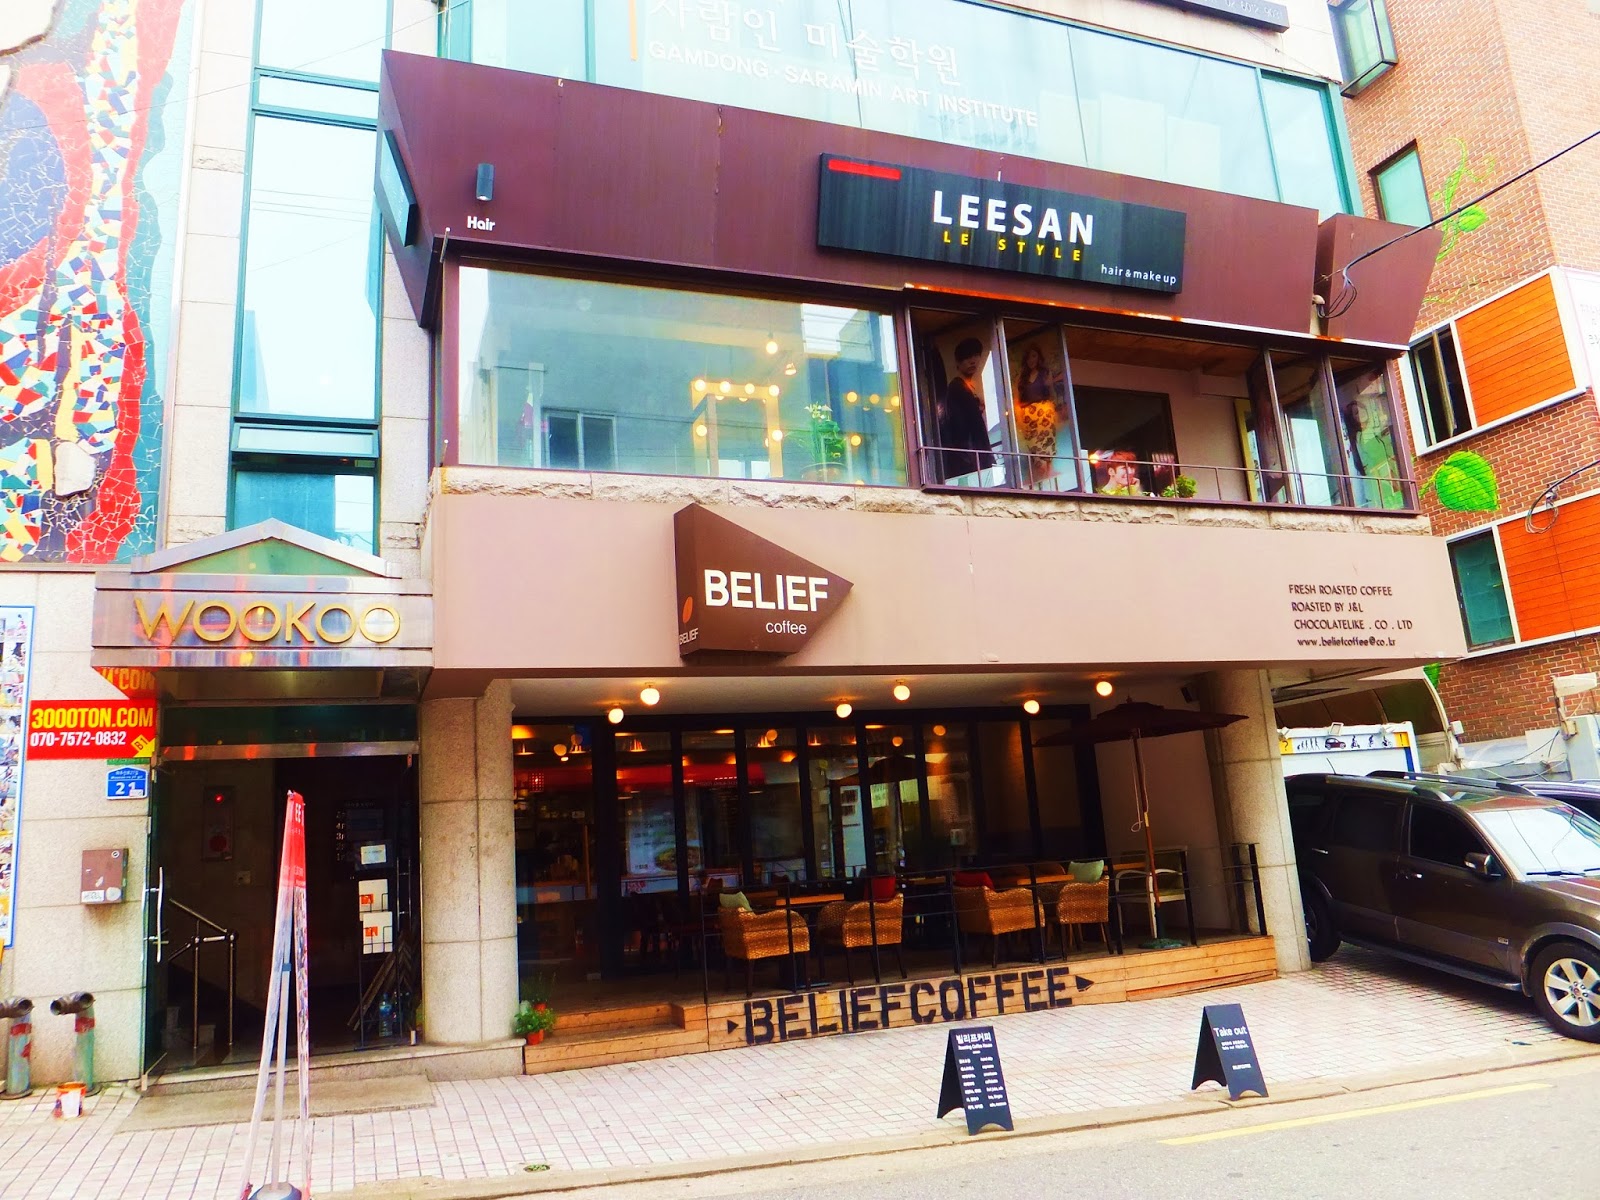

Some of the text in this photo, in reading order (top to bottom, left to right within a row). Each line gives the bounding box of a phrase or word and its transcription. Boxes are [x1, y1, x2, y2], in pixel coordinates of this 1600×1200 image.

[803, 22, 962, 88] 미술학원
[648, 40, 1039, 127] GAMDONG SARAMIN ART INSTITUTE
[467, 215, 496, 231] Hair
[932, 189, 1095, 246] LEESAN
[943, 230, 1082, 262] LE STYLE
[704, 569, 829, 612] BELIEF
[1288, 584, 1393, 597] FRESH ROASTED COFFEE
[1291, 601, 1364, 613] ROASTED BY J&L
[134, 598, 401, 644] WOOKOO
[765, 620, 807, 635] coffee
[1294, 619, 1365, 630] CHOCOLATELIKE
[1396, 620, 1413, 630] LTD
[679, 627, 699, 645] BELIEF
[32, 707, 154, 729] 3000TON.COM
[30, 731, 127, 747] 070-7572-0832
[134, 737, 148, 751] B1
[1213, 1026, 1247, 1037] Take out
